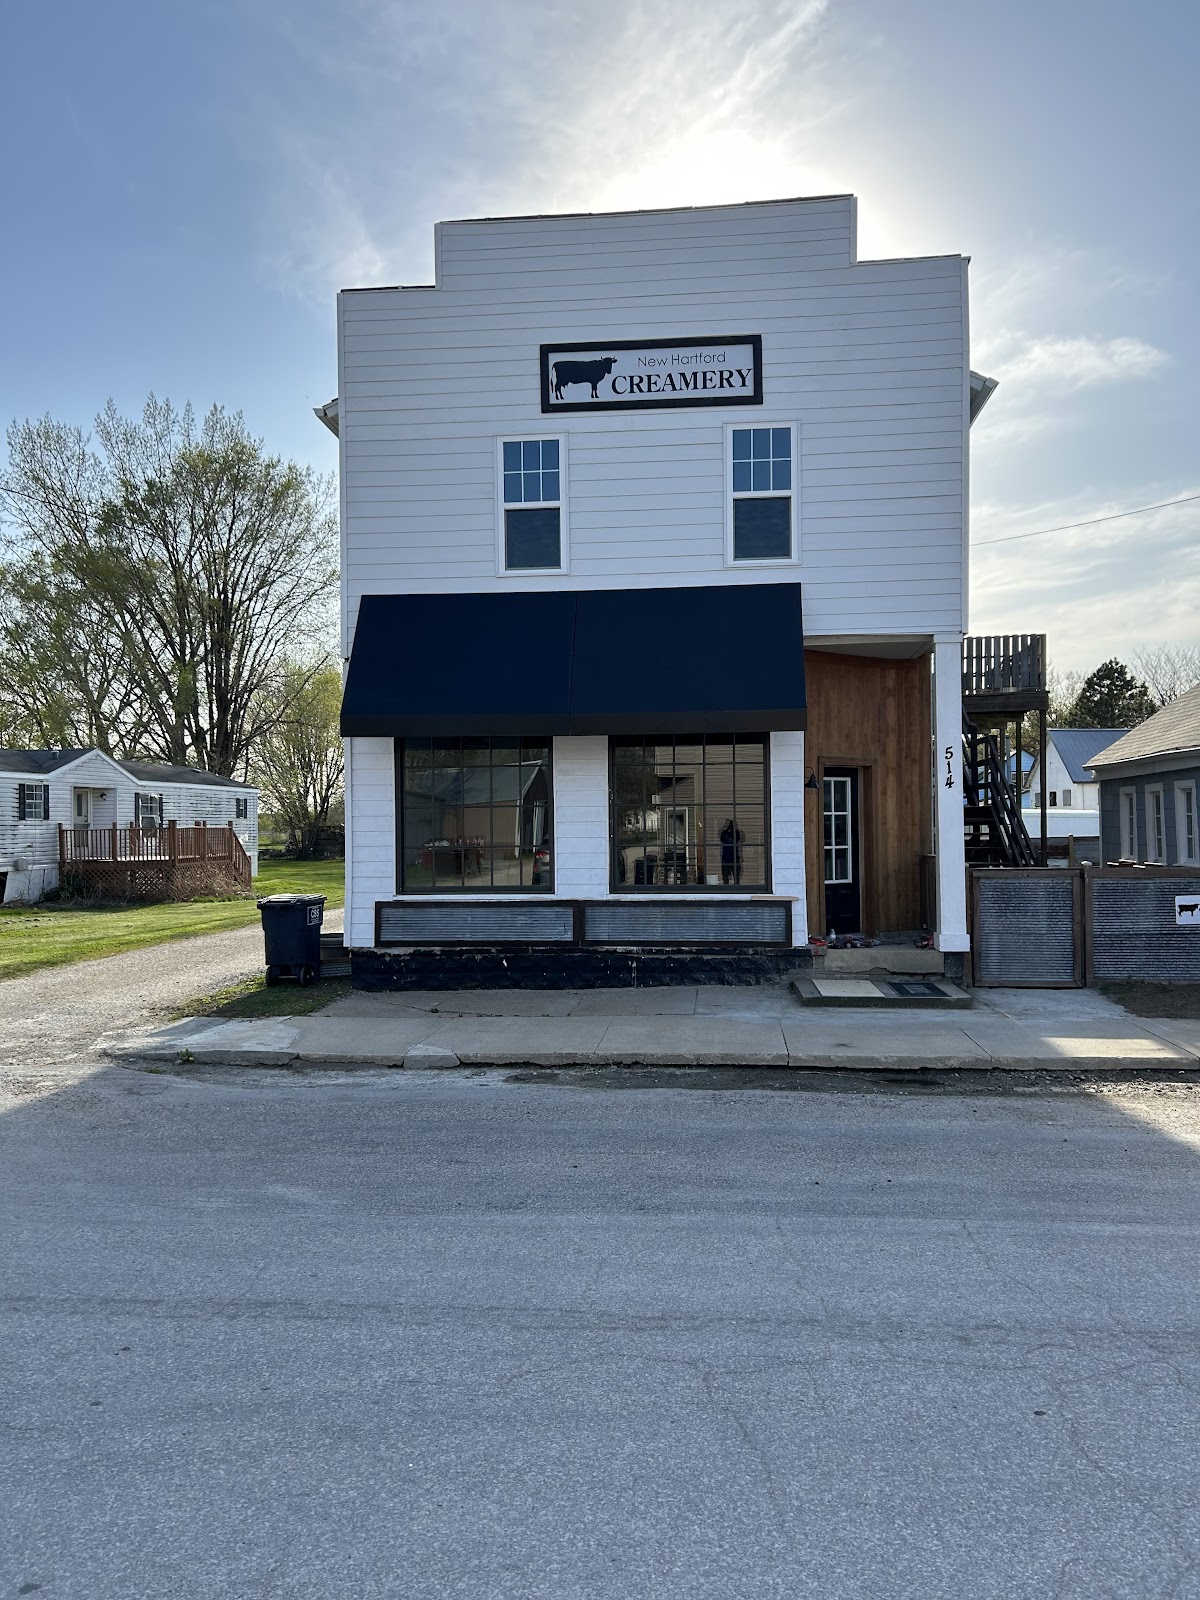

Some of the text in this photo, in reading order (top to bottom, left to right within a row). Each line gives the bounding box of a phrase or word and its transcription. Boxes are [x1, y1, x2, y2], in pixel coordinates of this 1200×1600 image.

[637, 351, 726, 368] New Hartford
[611, 368, 752, 394] CREAMERY
[944, 745, 955, 789] 514
